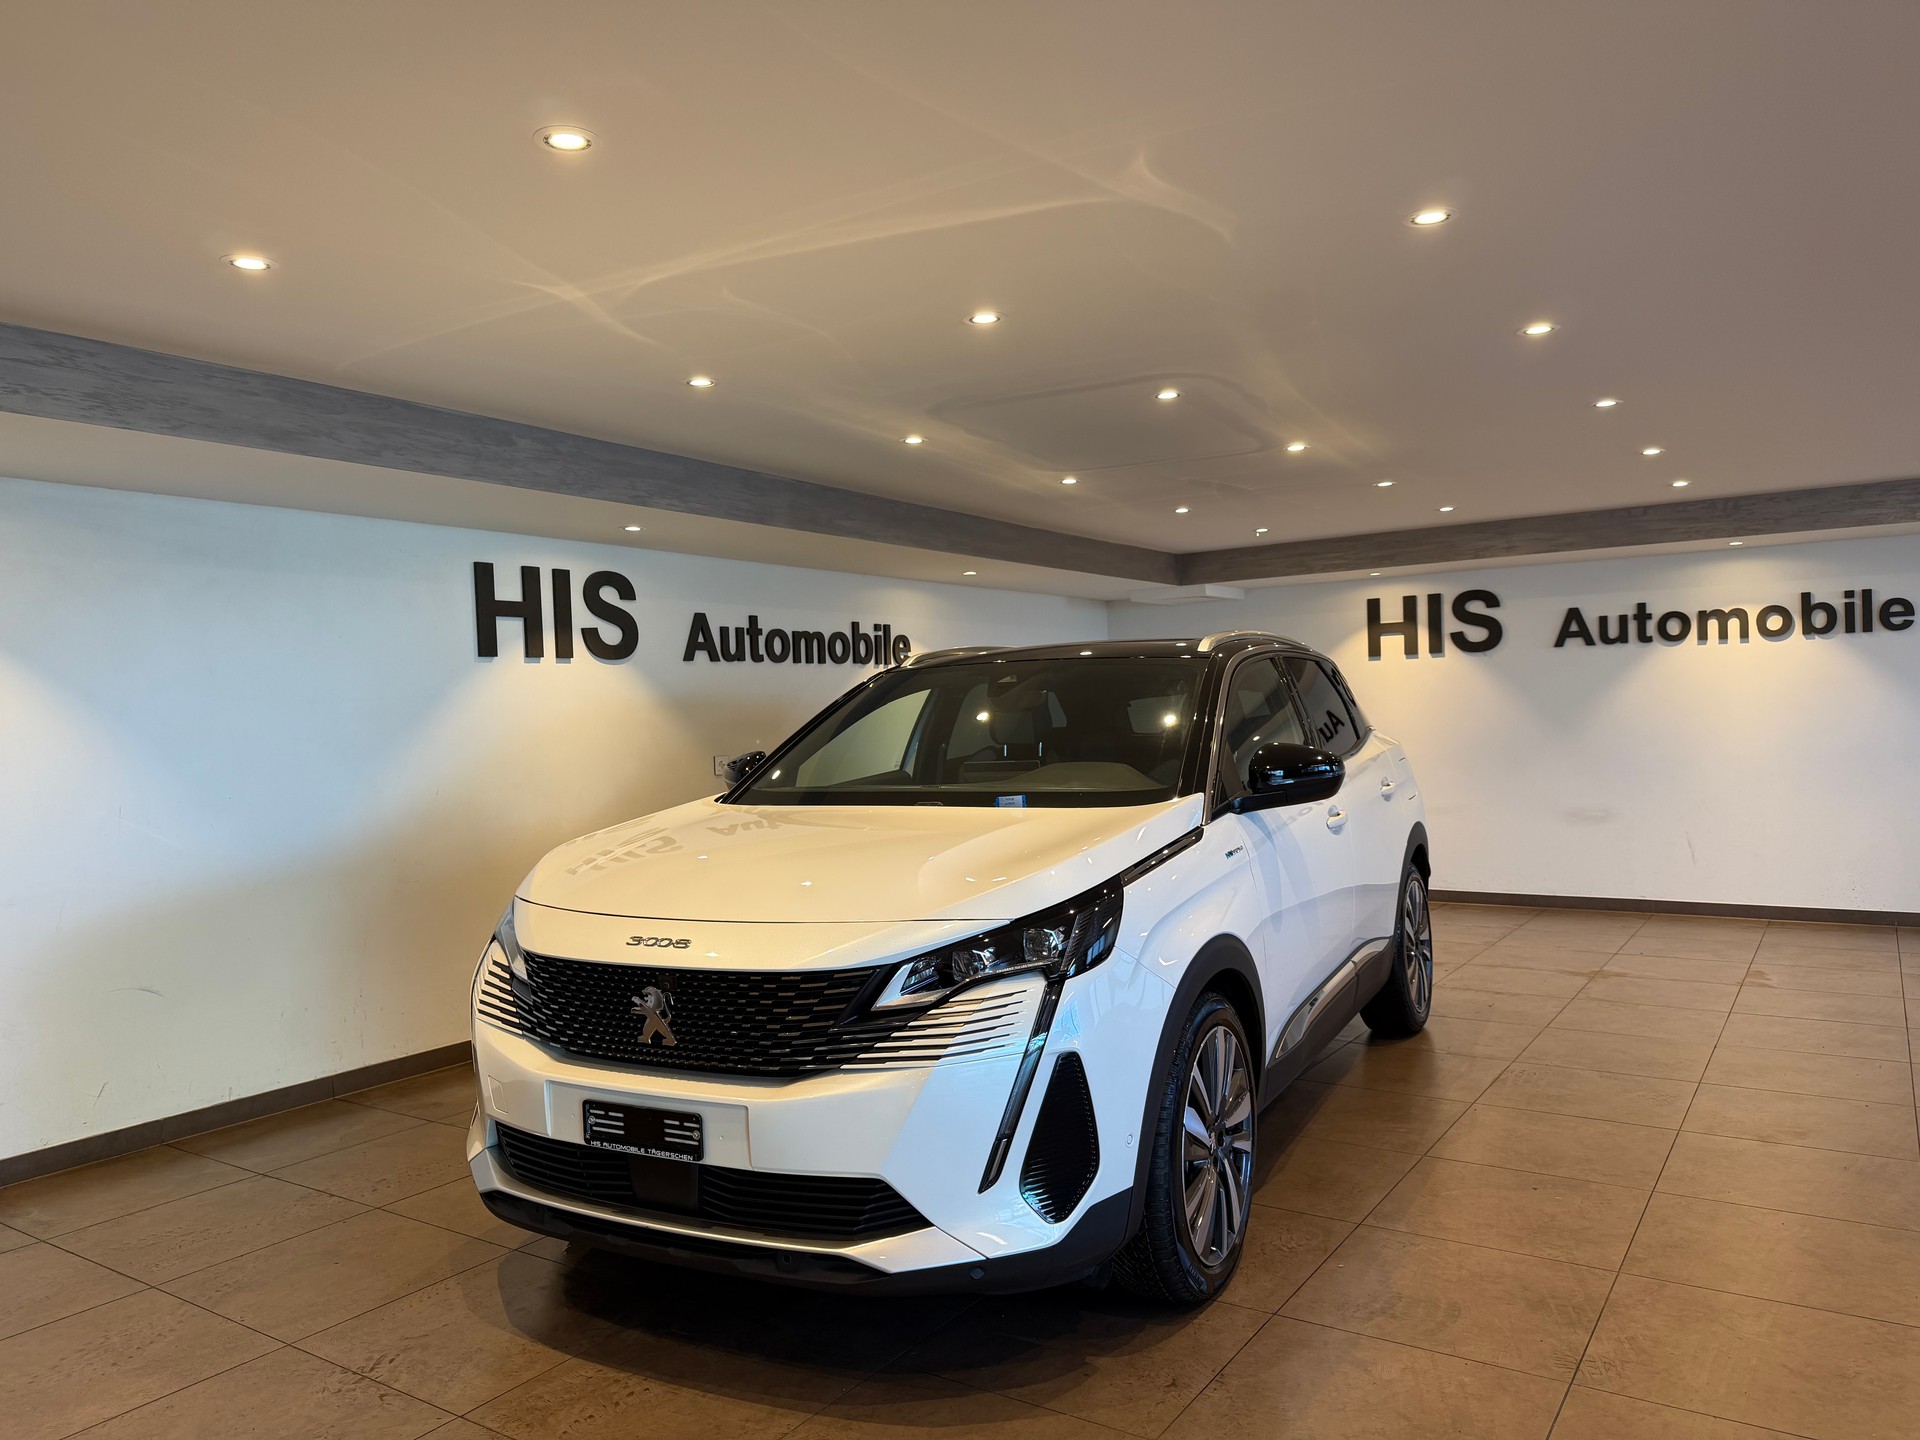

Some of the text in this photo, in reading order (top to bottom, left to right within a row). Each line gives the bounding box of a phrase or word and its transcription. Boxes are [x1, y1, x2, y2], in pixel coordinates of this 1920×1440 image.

[473, 561, 911, 666] HIS Automobile
[1366, 588, 1915, 658] HIS Automobile
[590, 1140, 601, 1148] HIS
[603, 1142, 645, 1154] AUTOMOBILE
